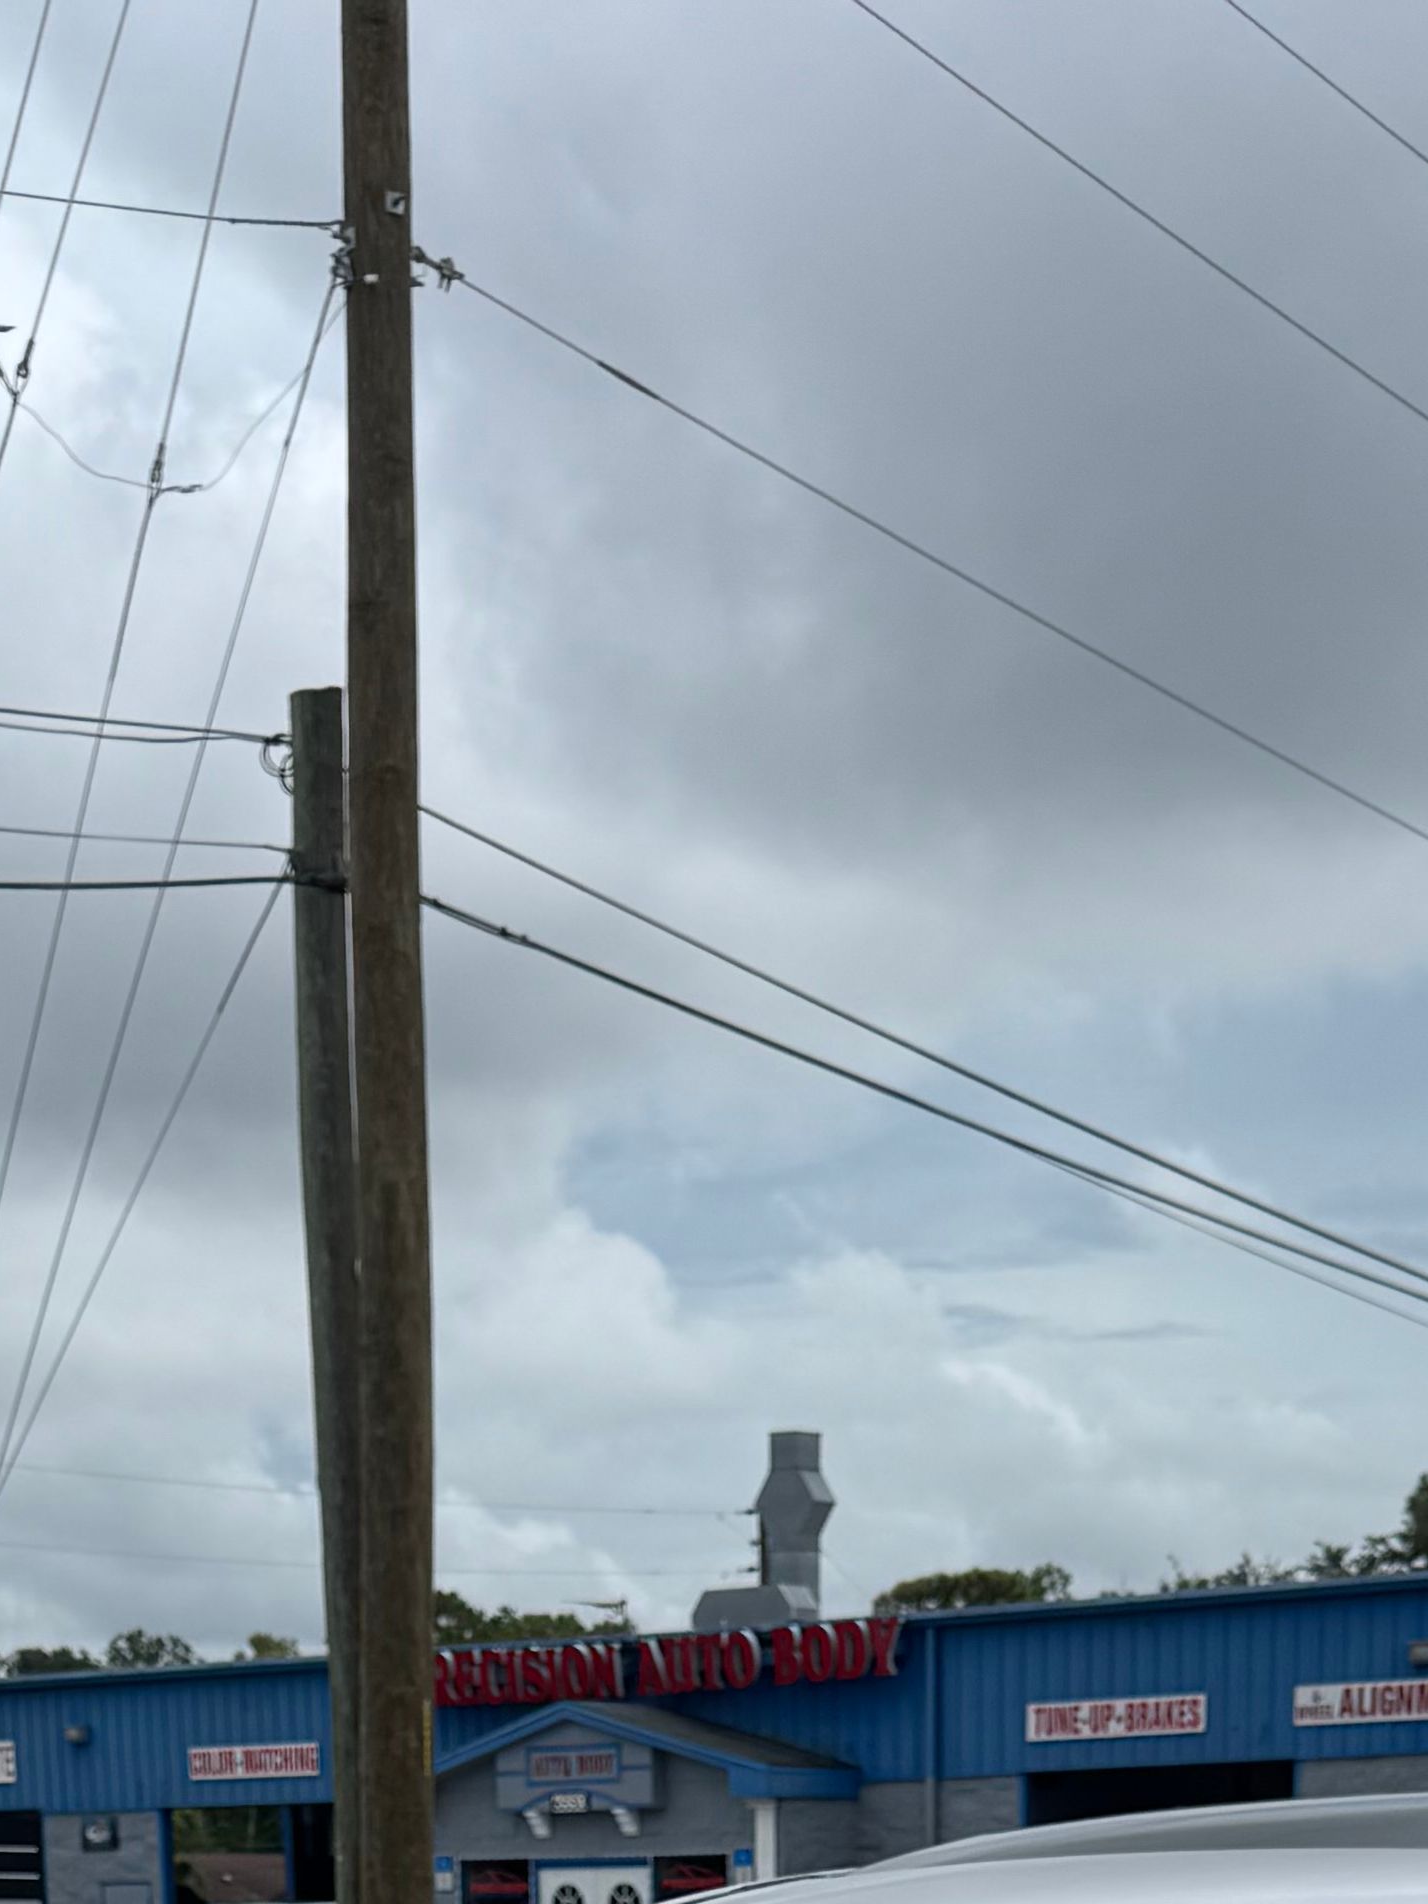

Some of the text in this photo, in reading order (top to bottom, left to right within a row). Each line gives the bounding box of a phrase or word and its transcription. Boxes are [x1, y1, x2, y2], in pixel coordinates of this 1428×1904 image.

[435, 1618, 900, 1706] RECISION AUTO BODY
